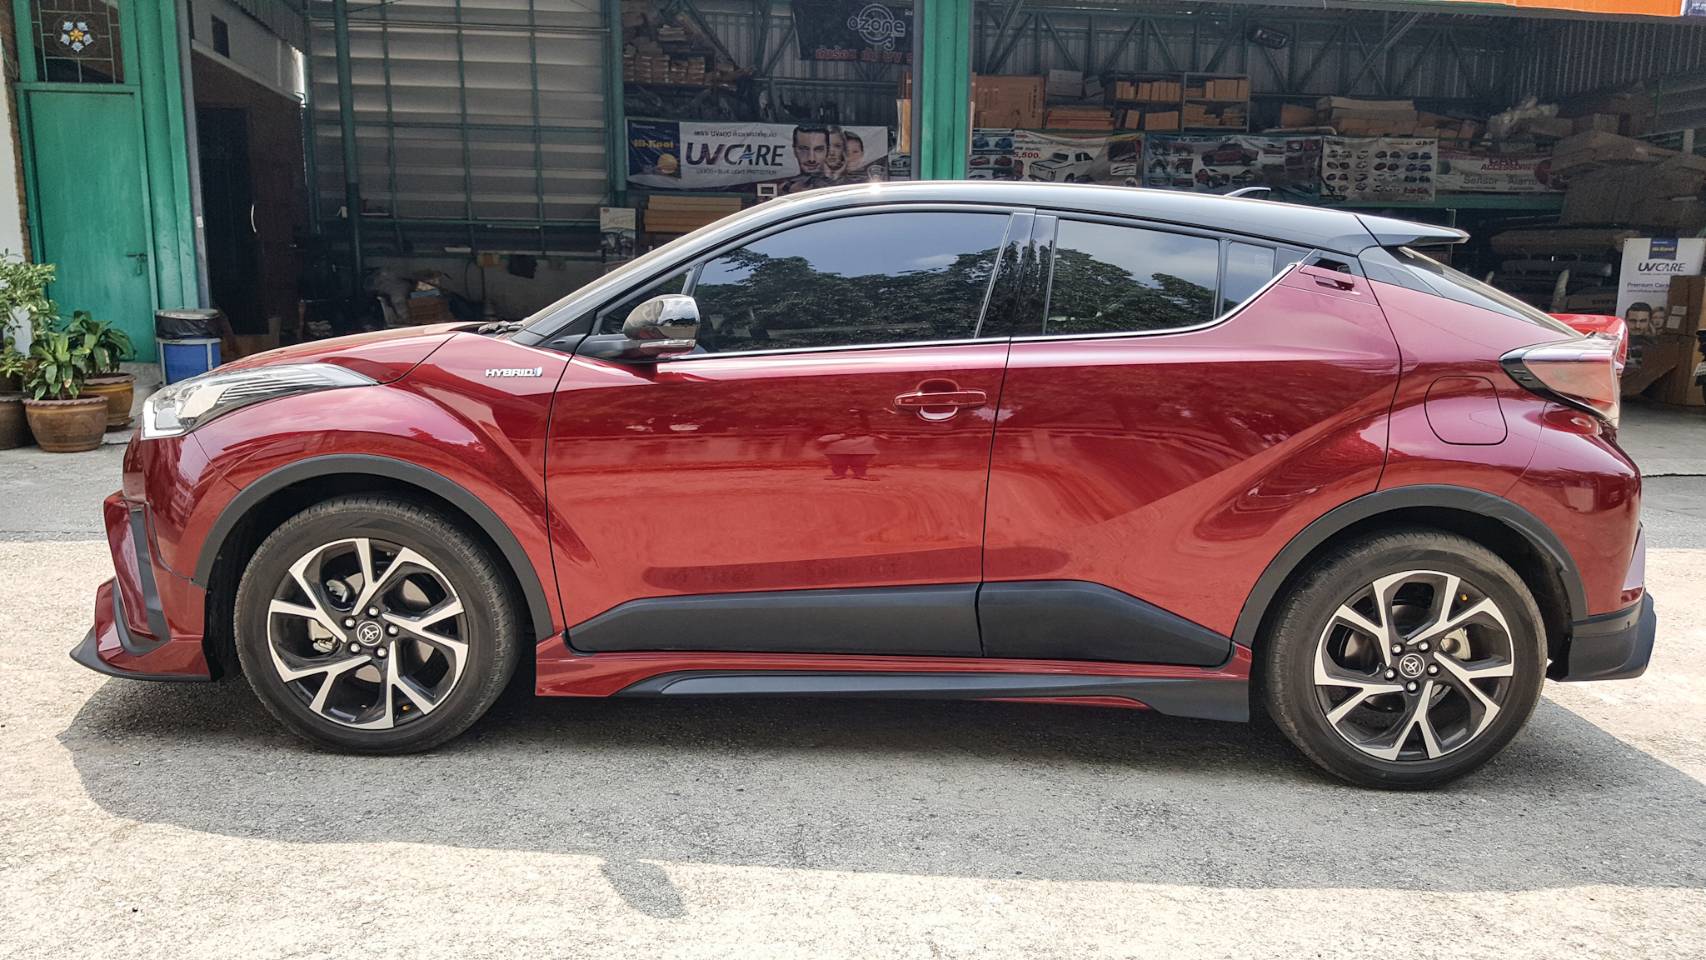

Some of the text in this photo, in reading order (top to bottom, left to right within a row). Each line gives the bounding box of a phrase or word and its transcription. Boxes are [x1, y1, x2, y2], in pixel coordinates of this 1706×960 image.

[685, 142, 786, 167] UVCARE
[1638, 262, 1686, 272] UVCARE
[485, 368, 535, 377] HYBRID
